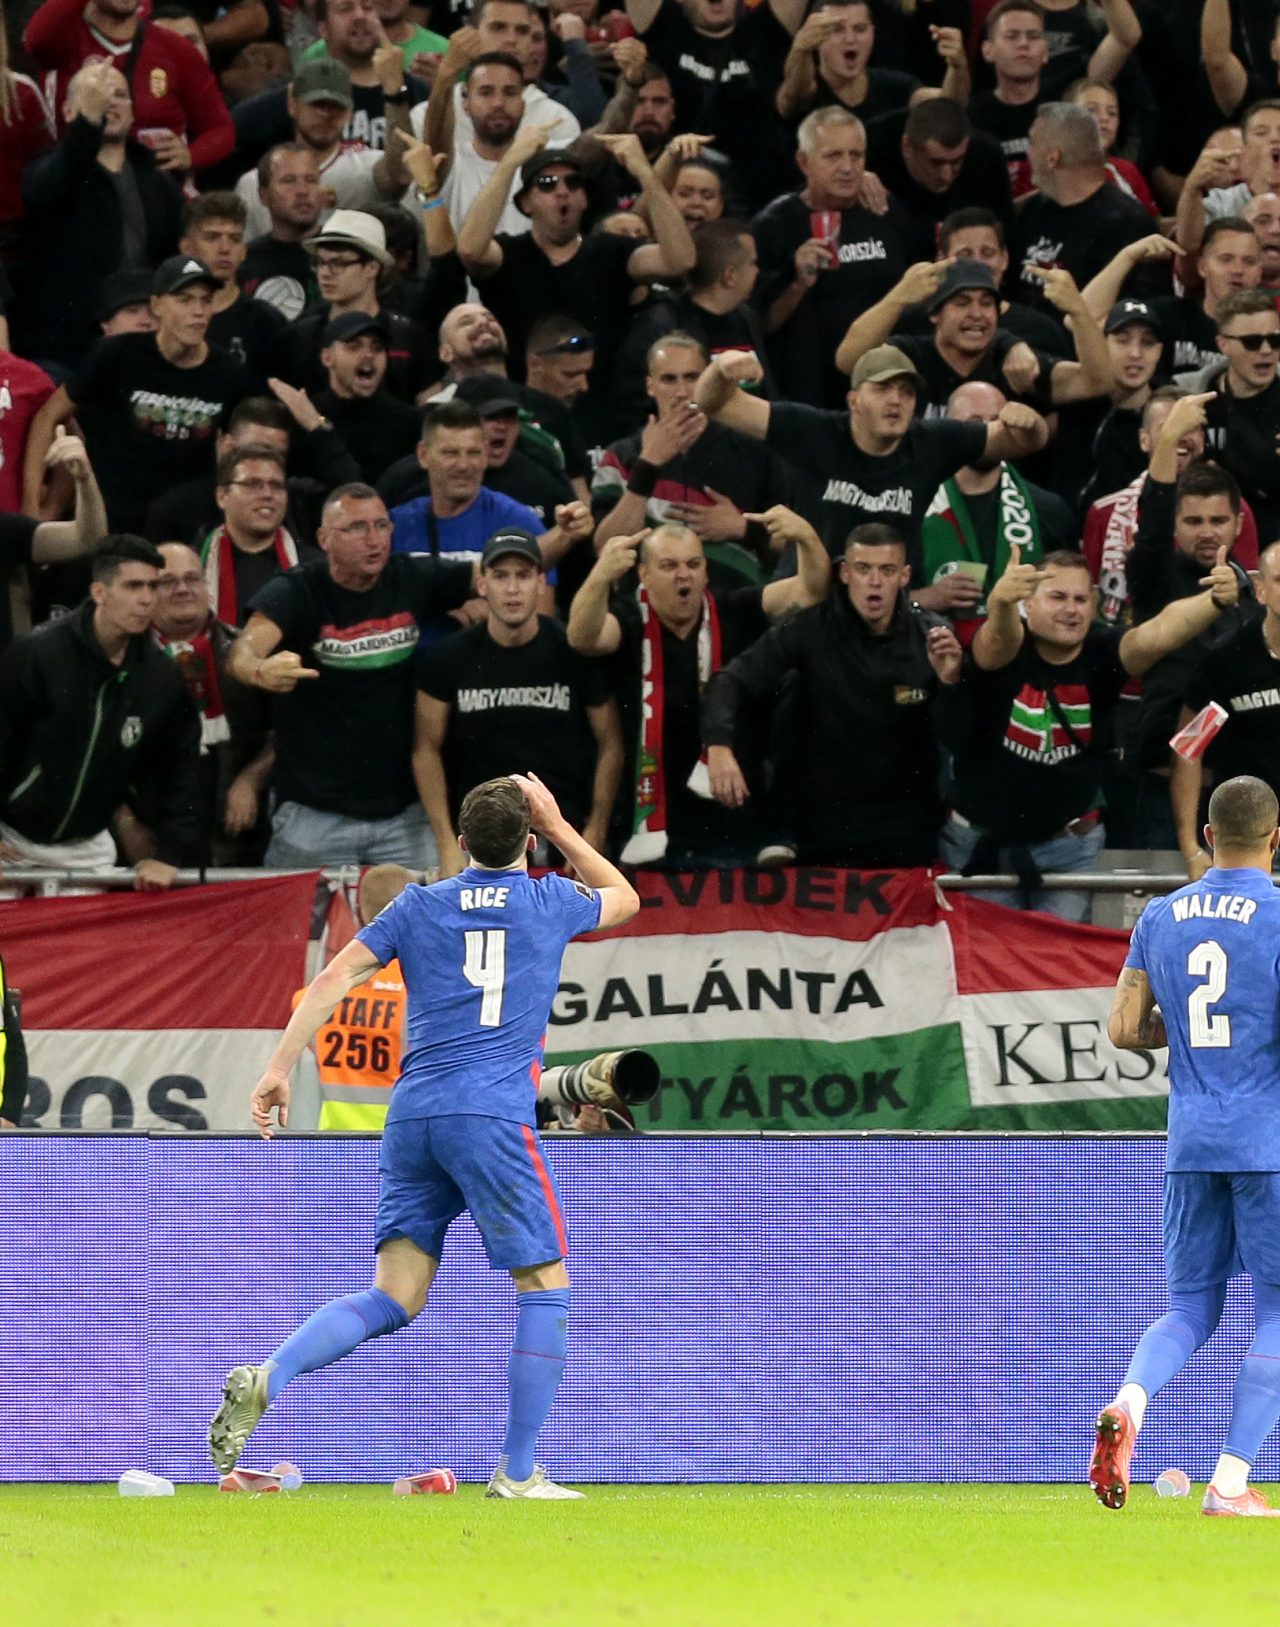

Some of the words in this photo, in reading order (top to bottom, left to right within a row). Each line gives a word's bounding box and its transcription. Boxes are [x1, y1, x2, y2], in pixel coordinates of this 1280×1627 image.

[457, 683, 570, 712] MAGYARORSZÁG
[460, 886, 510, 911] RICE
[1171, 893, 1258, 925] WALKER
[462, 929, 506, 1028] 4
[548, 958, 885, 1025] GALÁNTA
[1188, 940, 1231, 1048] 2
[327, 997, 398, 1029] TAFF
[322, 1031, 390, 1072] 256
[987, 1020, 1169, 1087] KES
[648, 1064, 909, 1122] TYÁROK
